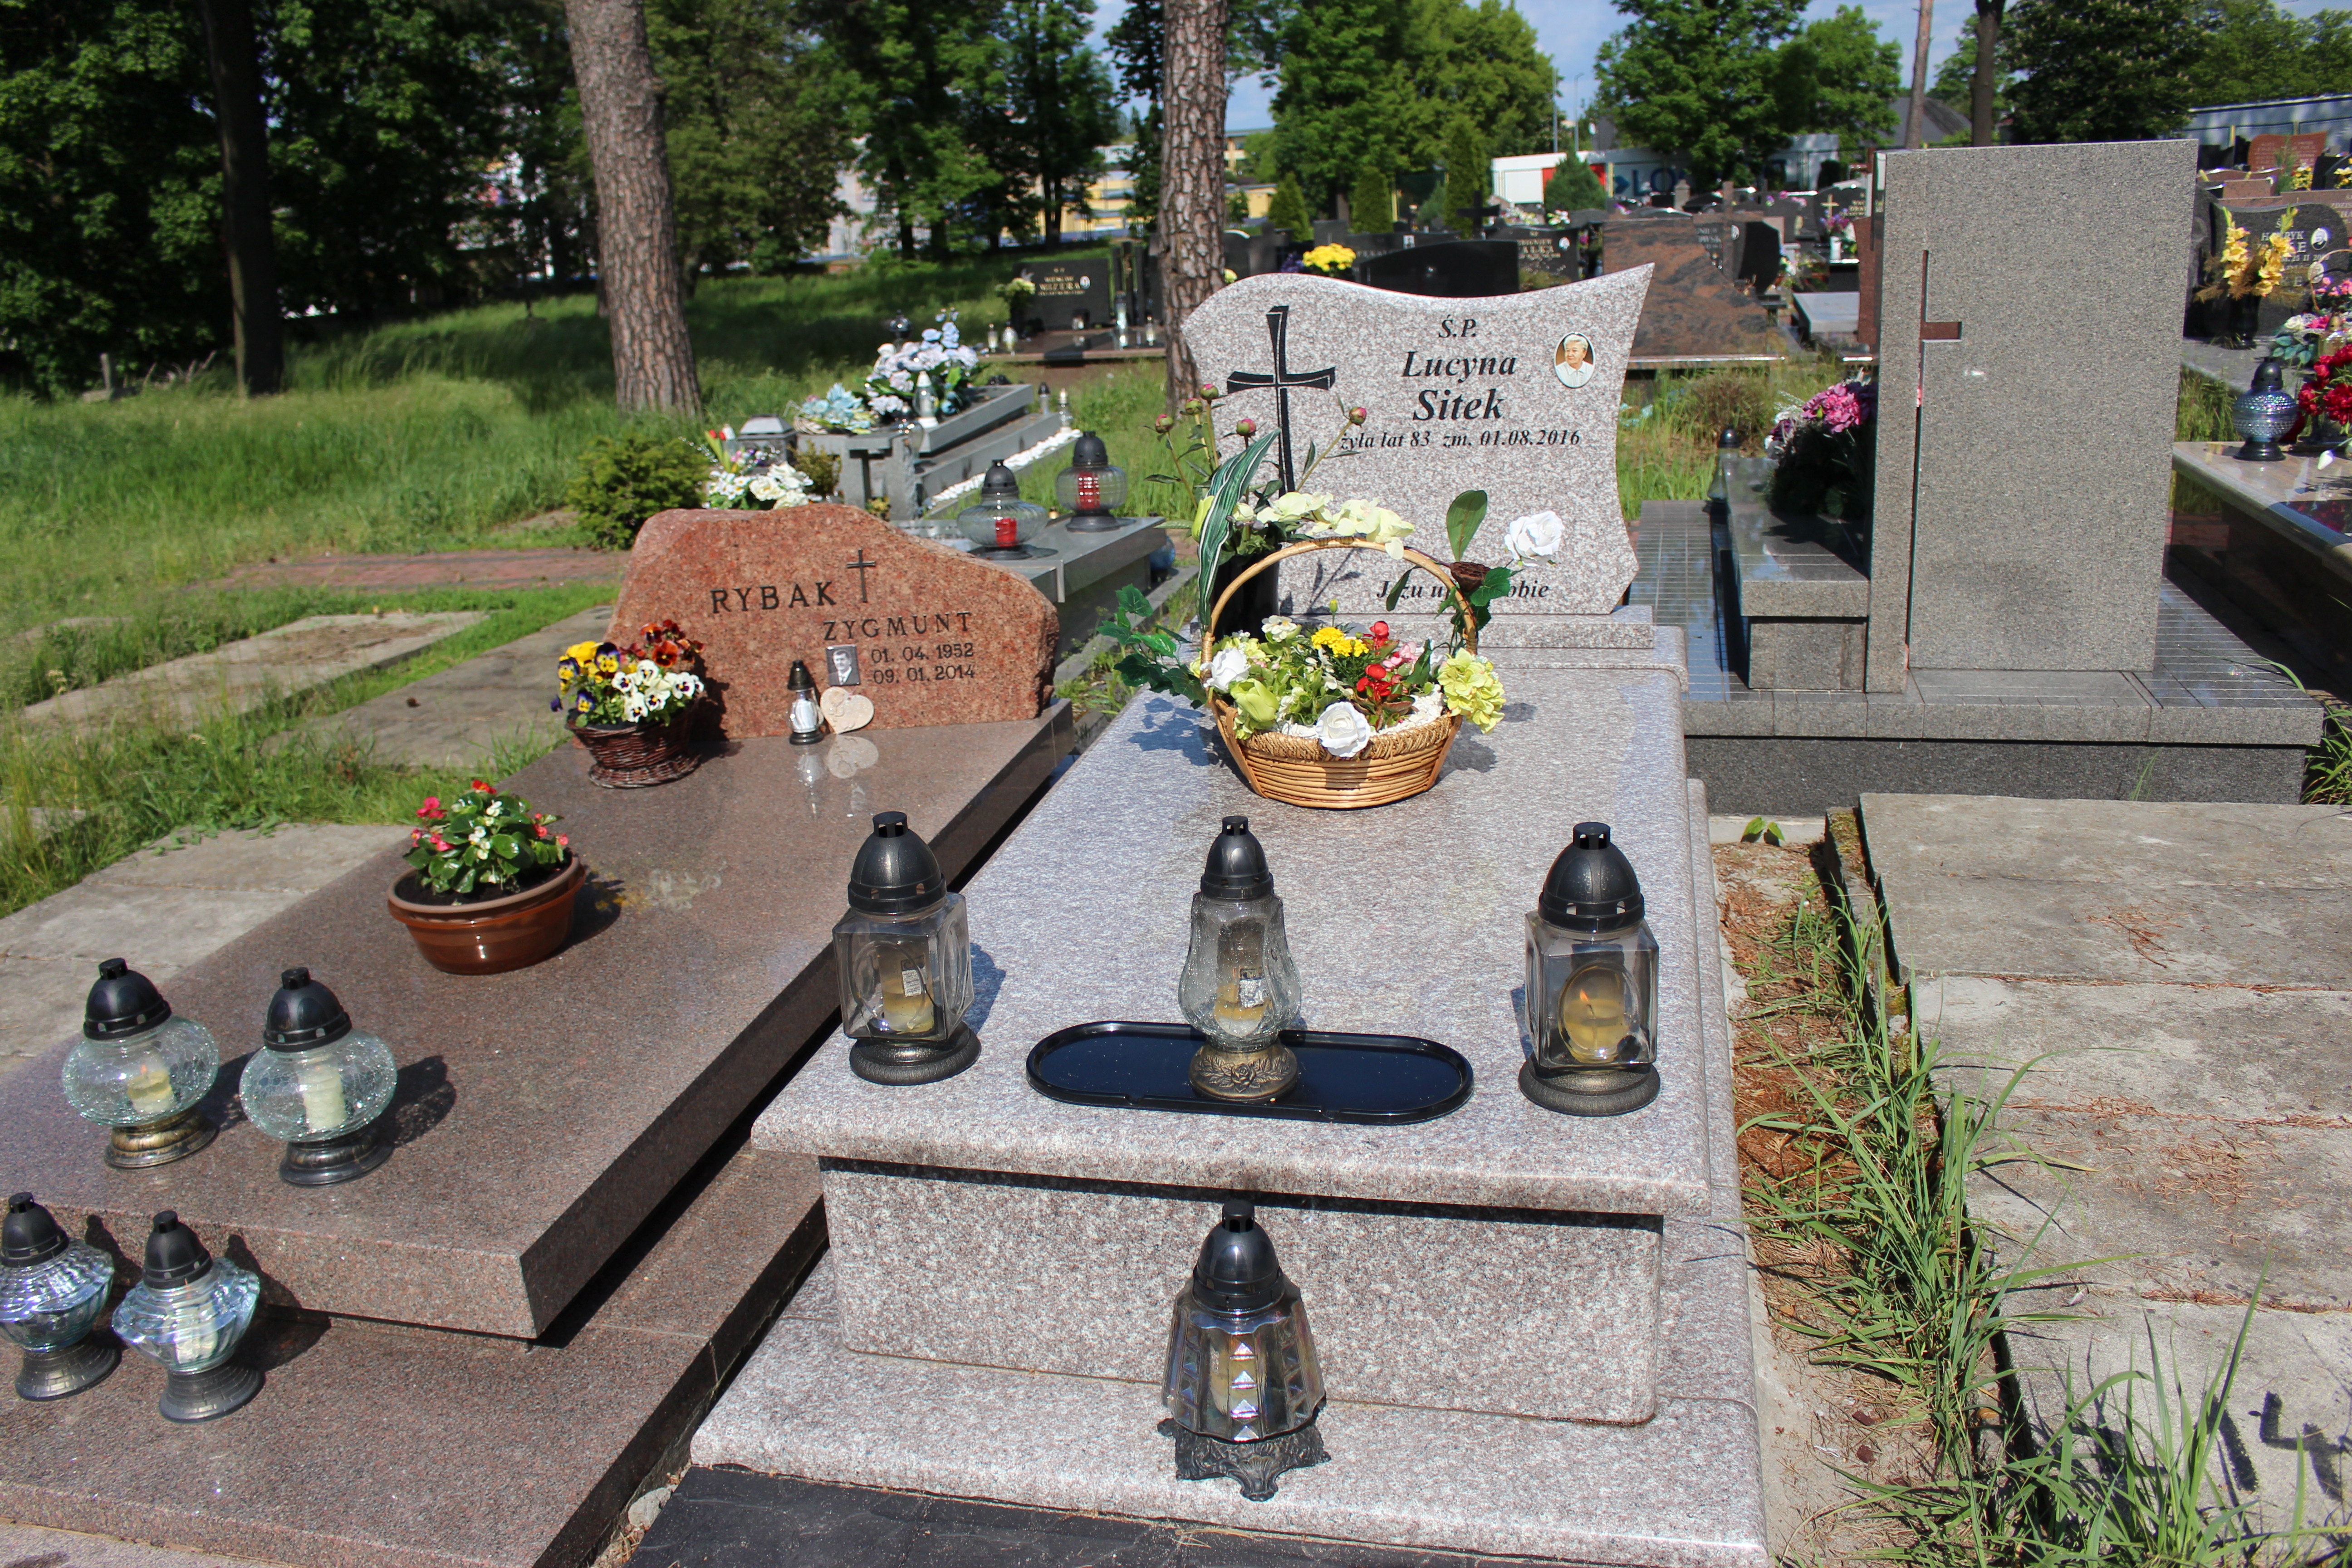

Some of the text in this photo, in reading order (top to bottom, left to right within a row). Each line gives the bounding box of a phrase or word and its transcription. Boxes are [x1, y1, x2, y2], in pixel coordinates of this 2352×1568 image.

[1439, 314, 1476, 338] Ś.P.
[1401, 351, 1517, 383] Lucyna
[1413, 388, 1504, 421] Sitek
[1381, 432, 1405, 447] lat
[1410, 431, 1430, 447] 83
[1443, 435, 1472, 448] zm.
[1480, 430, 1580, 446] 01.08.2016
[710, 581, 837, 613] RYBAK
[1377, 581, 1423, 598] Jzu
[1508, 580, 1550, 598] obie
[823, 611, 972, 641] ZYGMUNT
[871, 642, 974, 663] 01. 04. 1952
[873, 664, 975, 684] 09. 01. 2014
